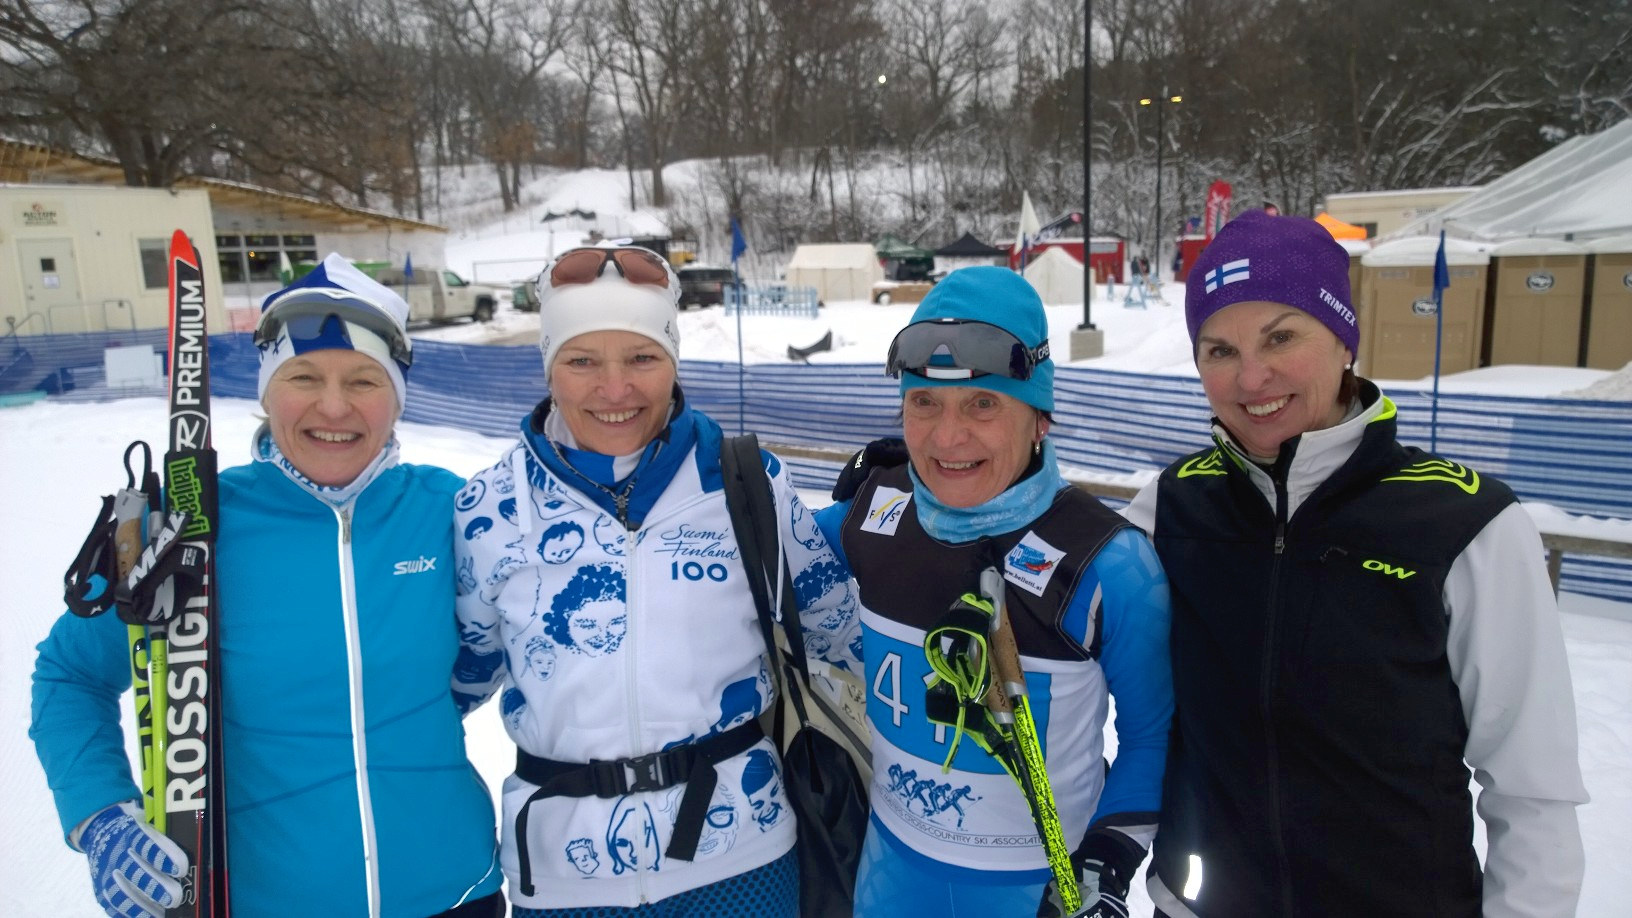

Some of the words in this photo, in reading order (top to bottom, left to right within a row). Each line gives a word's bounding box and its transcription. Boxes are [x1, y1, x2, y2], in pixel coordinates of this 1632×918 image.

[1320, 288, 1356, 326] TRIMTEX
[176, 280, 205, 405] PREMIUM
[661, 523, 729, 541] Suomi
[654, 540, 740, 560] Finland
[671, 561, 728, 582] 100
[1362, 560, 1417, 579] OW
[974, 836, 989, 845] SKI
[991, 836, 1042, 846] ASSOCIATI
